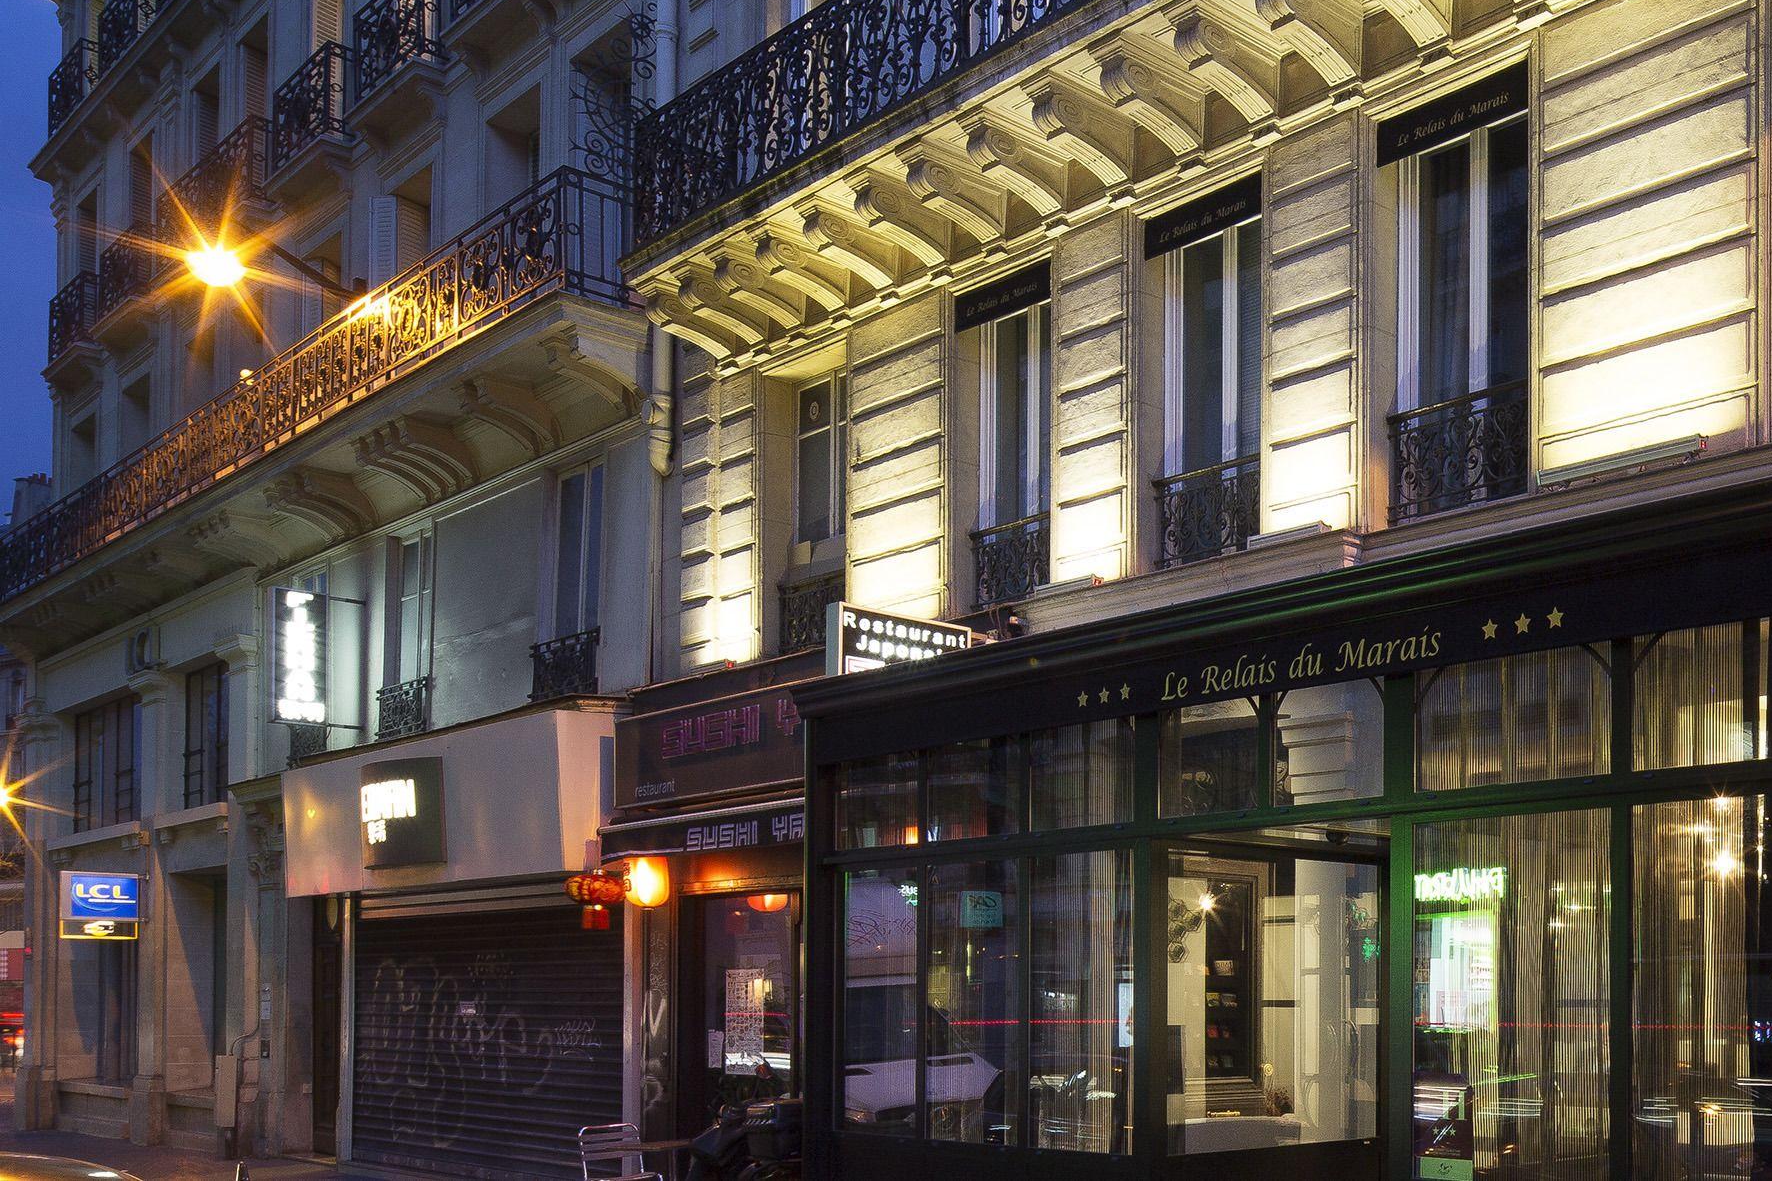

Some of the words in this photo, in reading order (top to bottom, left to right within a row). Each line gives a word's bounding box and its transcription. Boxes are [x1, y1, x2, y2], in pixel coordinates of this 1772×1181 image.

[1397, 133, 1409, 147] Le
[1413, 116, 1447, 140] Relais
[1449, 109, 1465, 126] du
[1468, 91, 1510, 118] Marais
[842, 610, 966, 650] Restaurant
[1161, 671, 1188, 701] Le
[1200, 654, 1277, 695] Relais
[1288, 643, 1323, 679] du
[1335, 625, 1441, 672] Marais
[661, 703, 761, 760] SUSHI
[635, 778, 676, 798] restaurant
[686, 820, 758, 852] SUSHI
[75, 883, 130, 899] LCL
